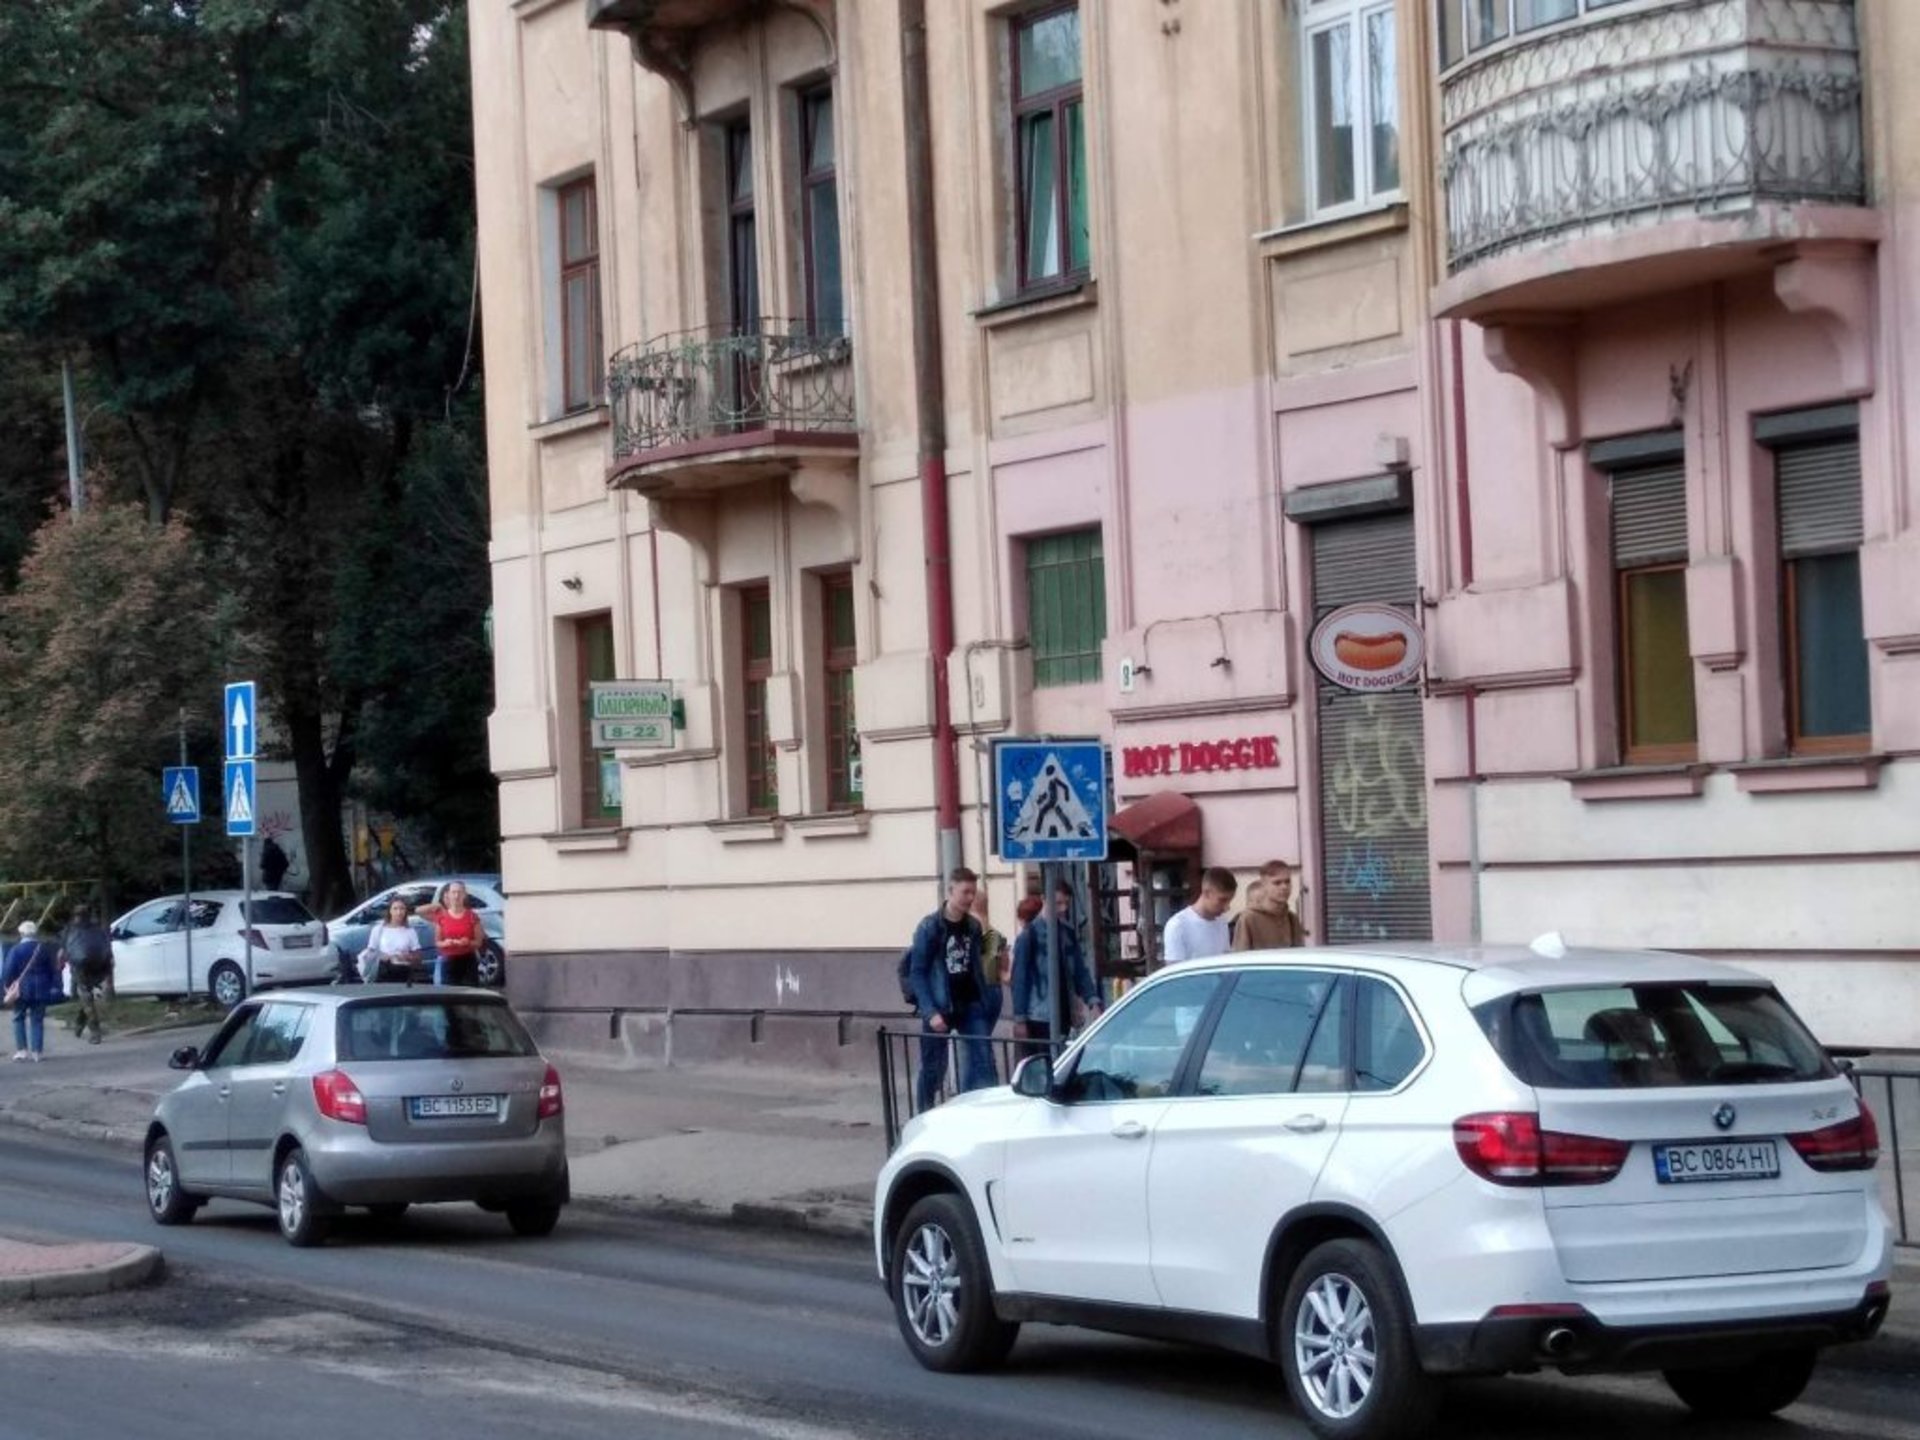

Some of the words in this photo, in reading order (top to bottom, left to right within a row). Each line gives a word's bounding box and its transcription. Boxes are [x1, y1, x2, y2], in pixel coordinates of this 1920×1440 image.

[1337, 671, 1361, 686] HOT
[1363, 671, 1404, 688] DOGGIE
[1122, 744, 1173, 778] HOT
[1178, 735, 1281, 775] DOGGIE
[422, 1099, 441, 1114] BC
[444, 1098, 473, 1113] 1153
[1668, 1149, 1698, 1173] BC
[1701, 1147, 1747, 1171] 0864
[1748, 1146, 1772, 1169] HI
